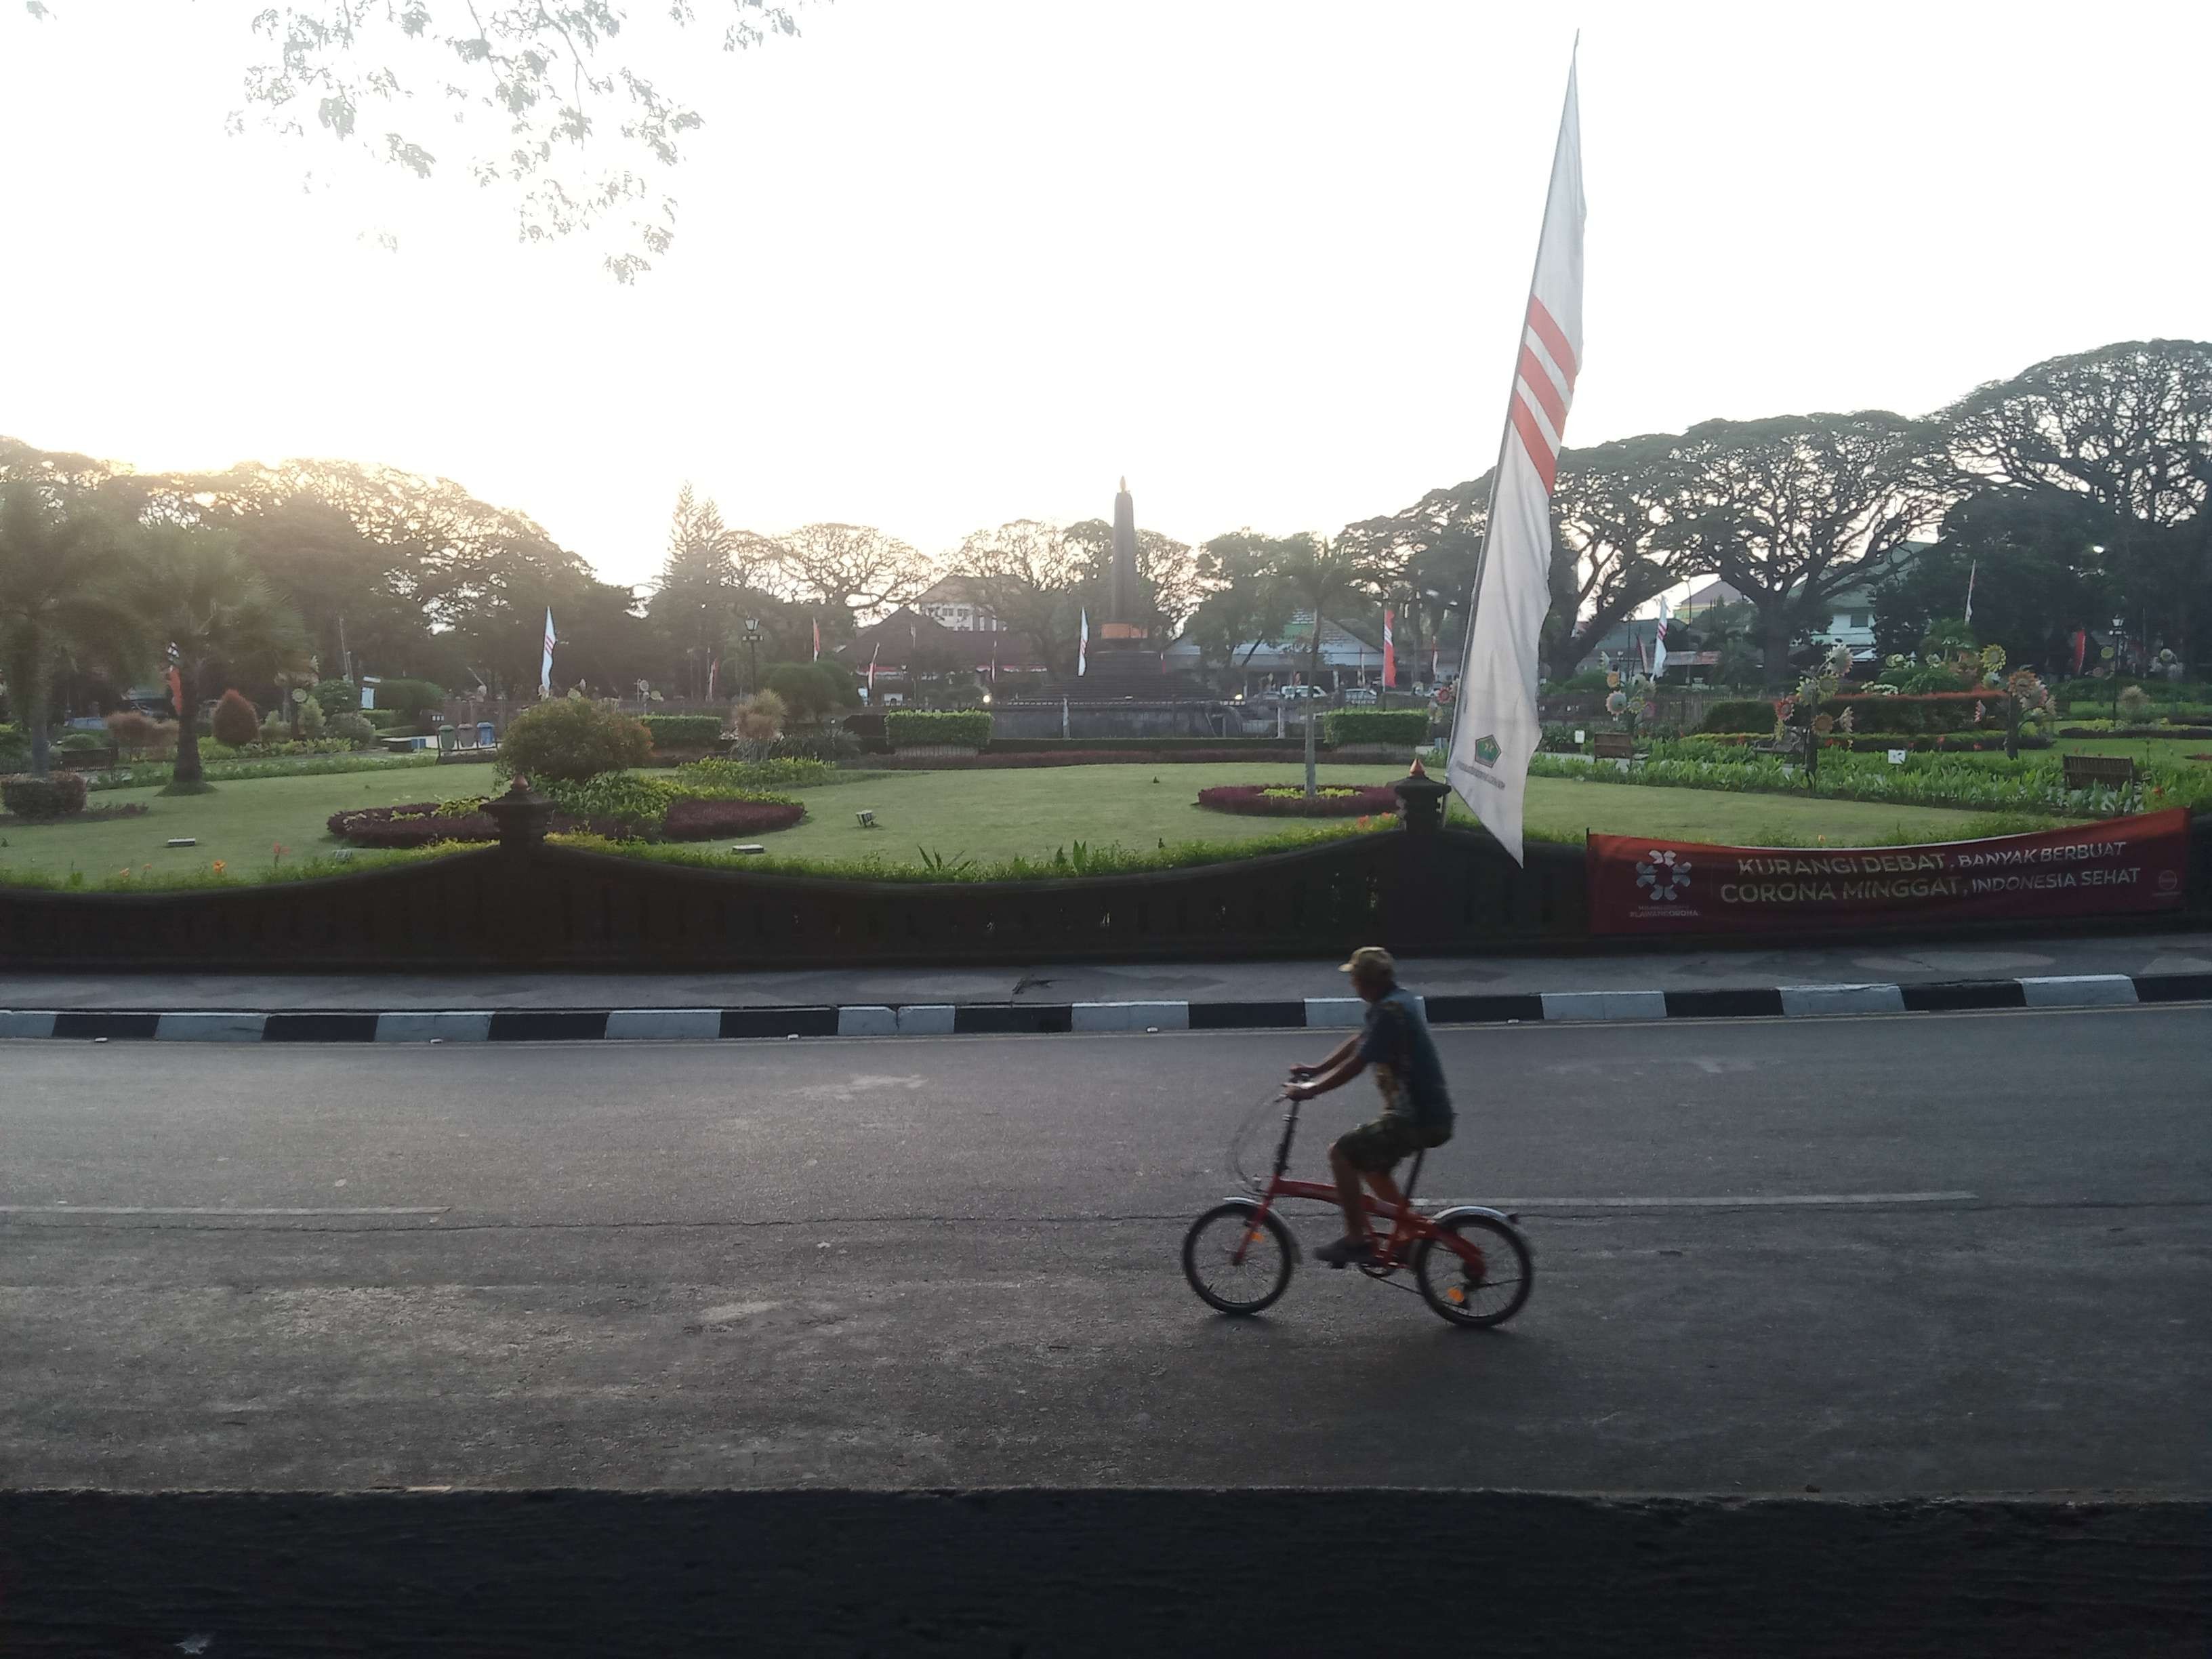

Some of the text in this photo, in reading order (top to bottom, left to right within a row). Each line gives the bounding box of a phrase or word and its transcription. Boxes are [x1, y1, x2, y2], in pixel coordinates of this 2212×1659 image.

[1738, 857, 1858, 875] KURANGI
[1958, 848, 2037, 868] BANYAK
[2040, 842, 2127, 862] BERBUAT
[1720, 881, 1837, 903] CORONA
[1971, 872, 2077, 893] INDONESIA
[2081, 867, 2141, 886] SEHAT
